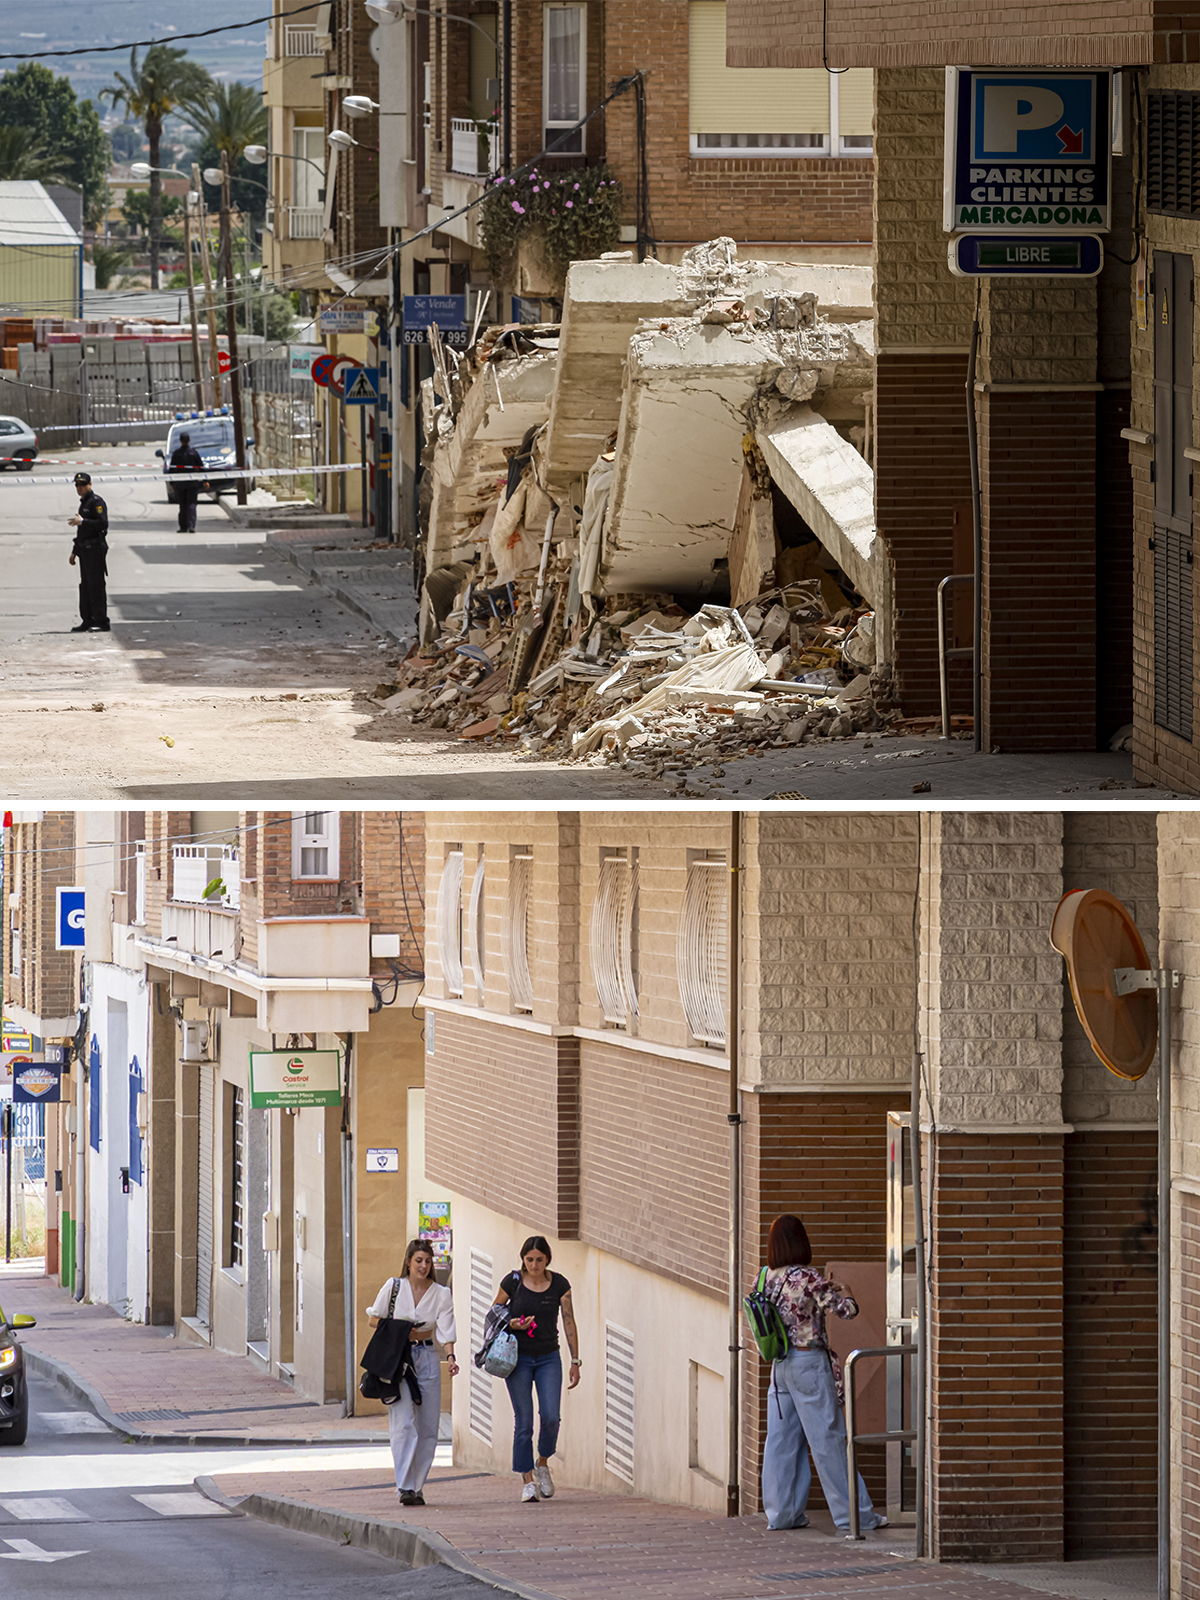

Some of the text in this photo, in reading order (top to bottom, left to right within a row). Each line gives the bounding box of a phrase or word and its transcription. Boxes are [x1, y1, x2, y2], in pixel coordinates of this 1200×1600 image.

[984, 85, 1064, 152] P
[969, 168, 1095, 184] PARKING
[970, 187, 1094, 202] CLIENTES
[959, 206, 1103, 224] MERCADONA
[1006, 247, 1050, 262] LIBRE
[414, 298, 456, 309] Se Vende
[404, 331, 467, 343] 626 97 995
